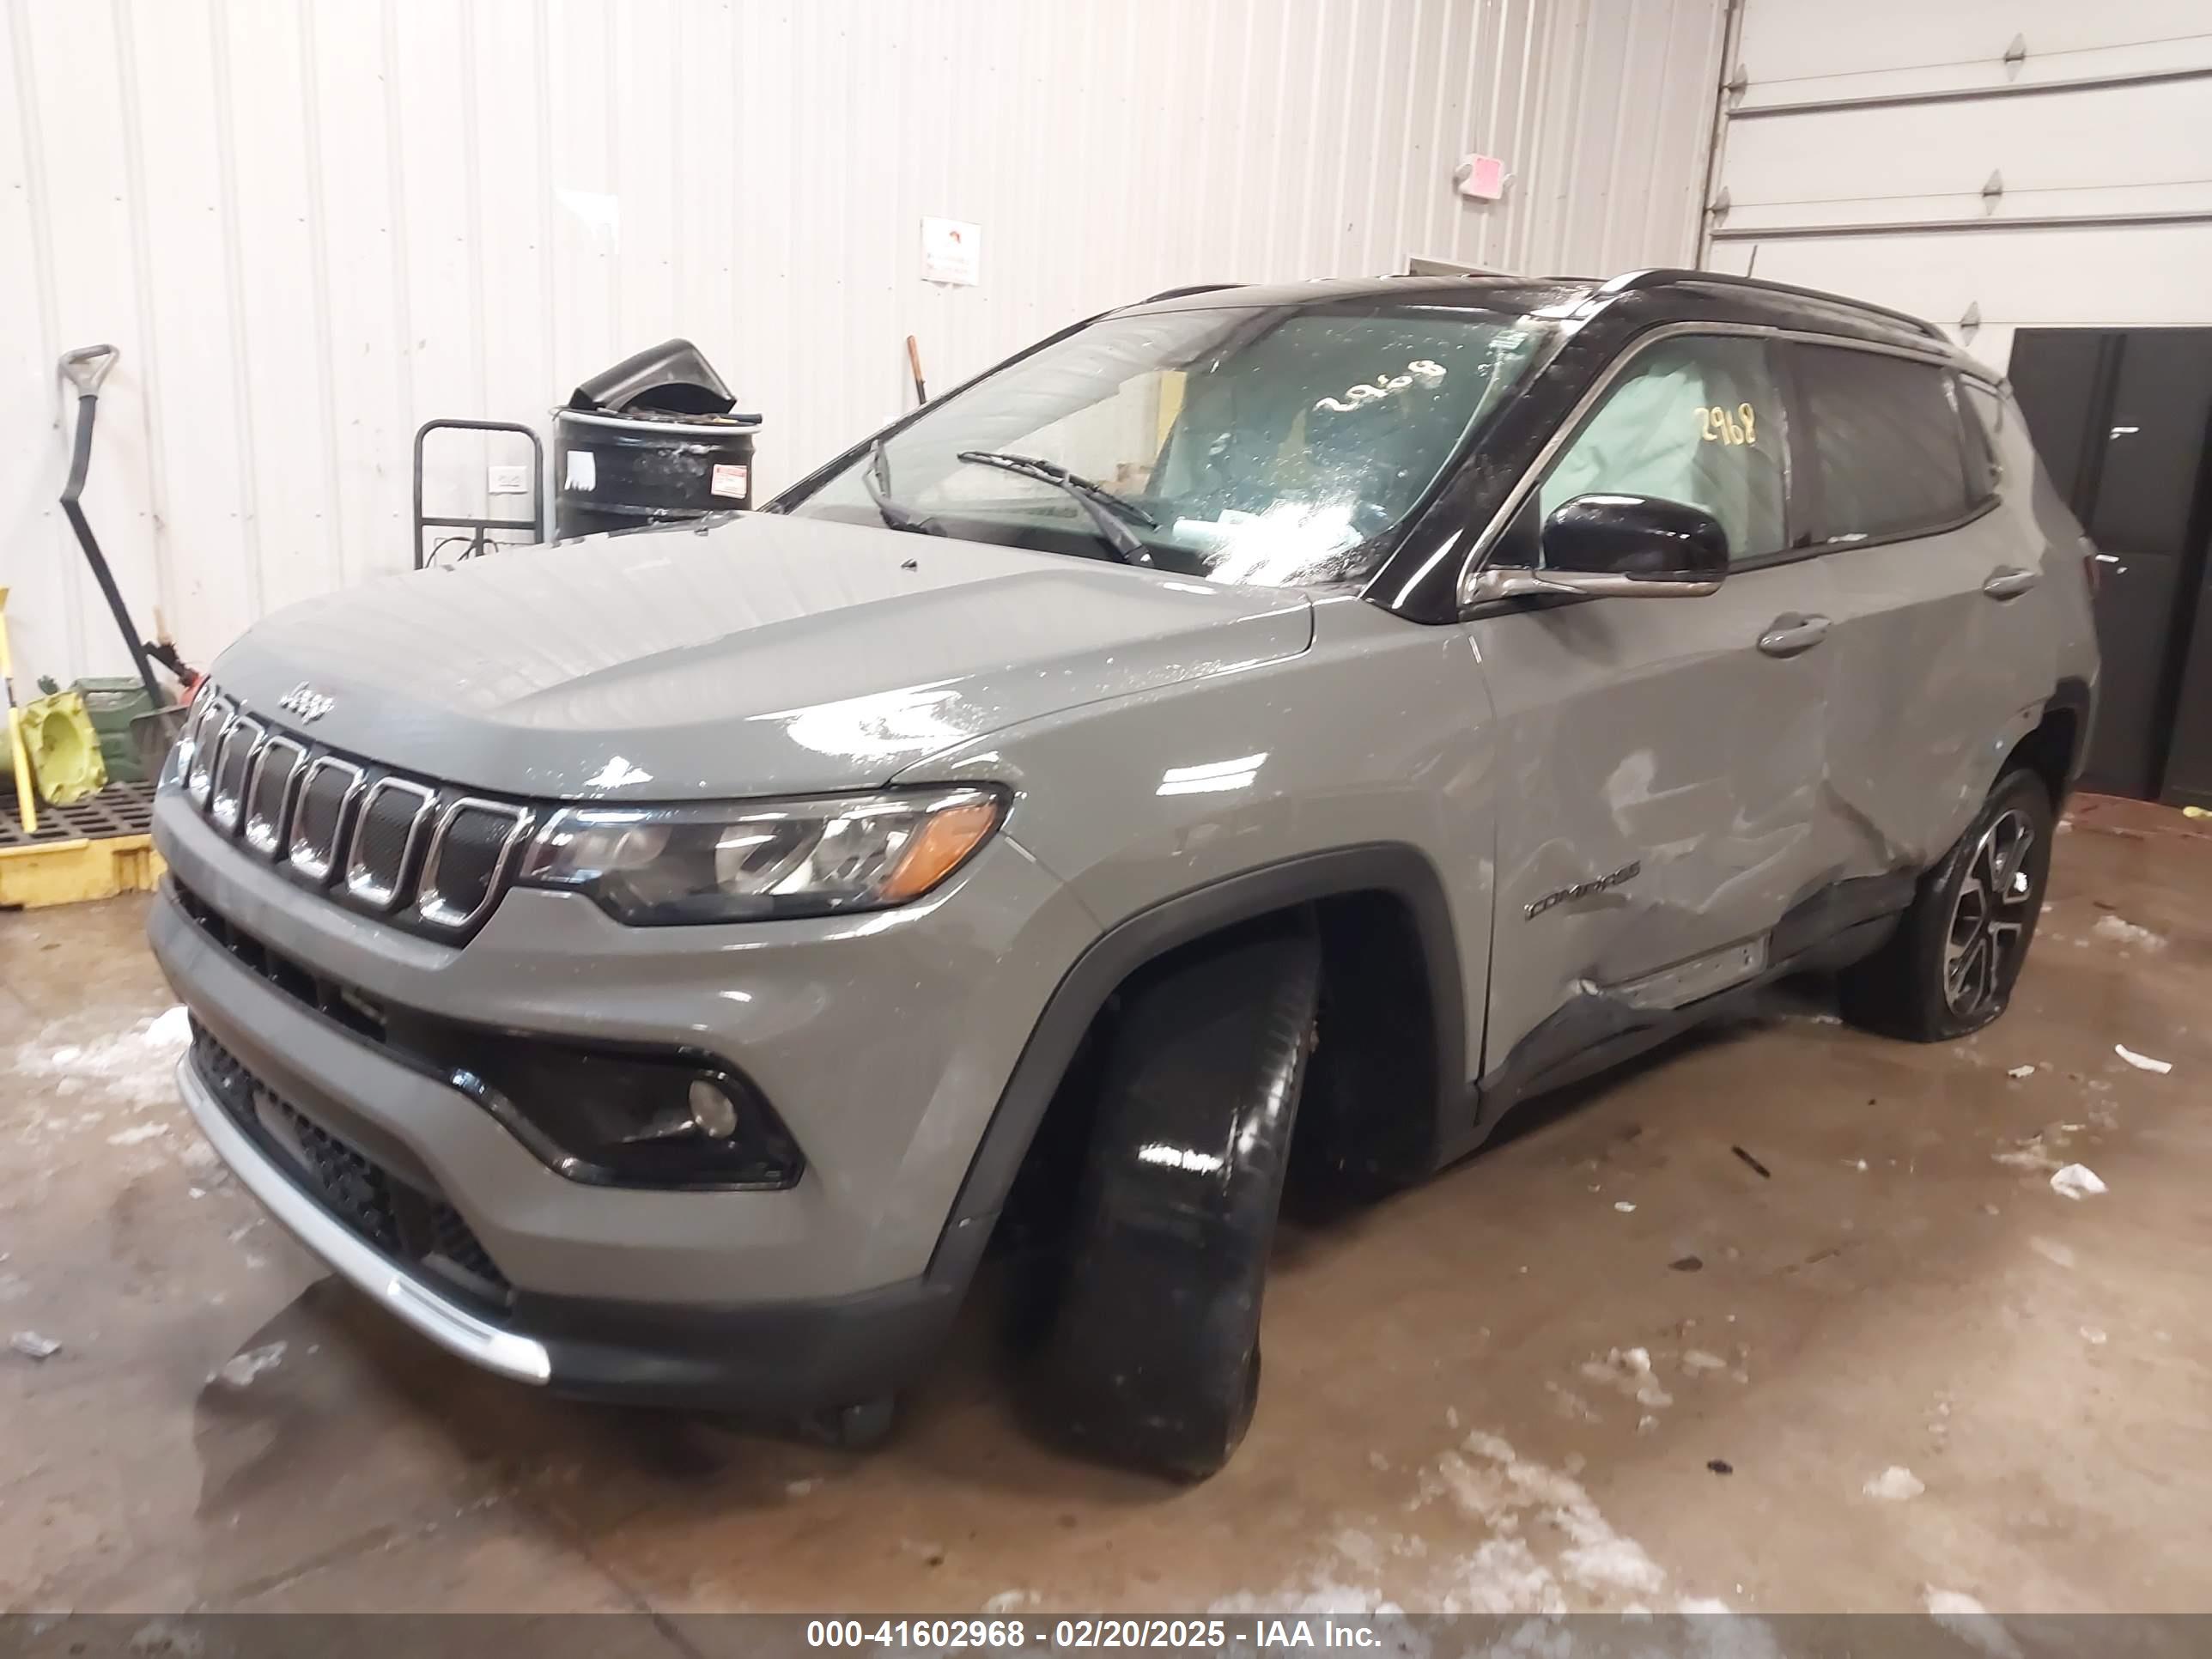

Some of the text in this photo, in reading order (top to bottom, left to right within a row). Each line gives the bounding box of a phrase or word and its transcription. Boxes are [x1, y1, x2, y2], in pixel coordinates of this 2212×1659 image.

[1312, 359, 1448, 412] 2968
[1693, 402, 1756, 446] 2968
[277, 681, 335, 725] Jeep
